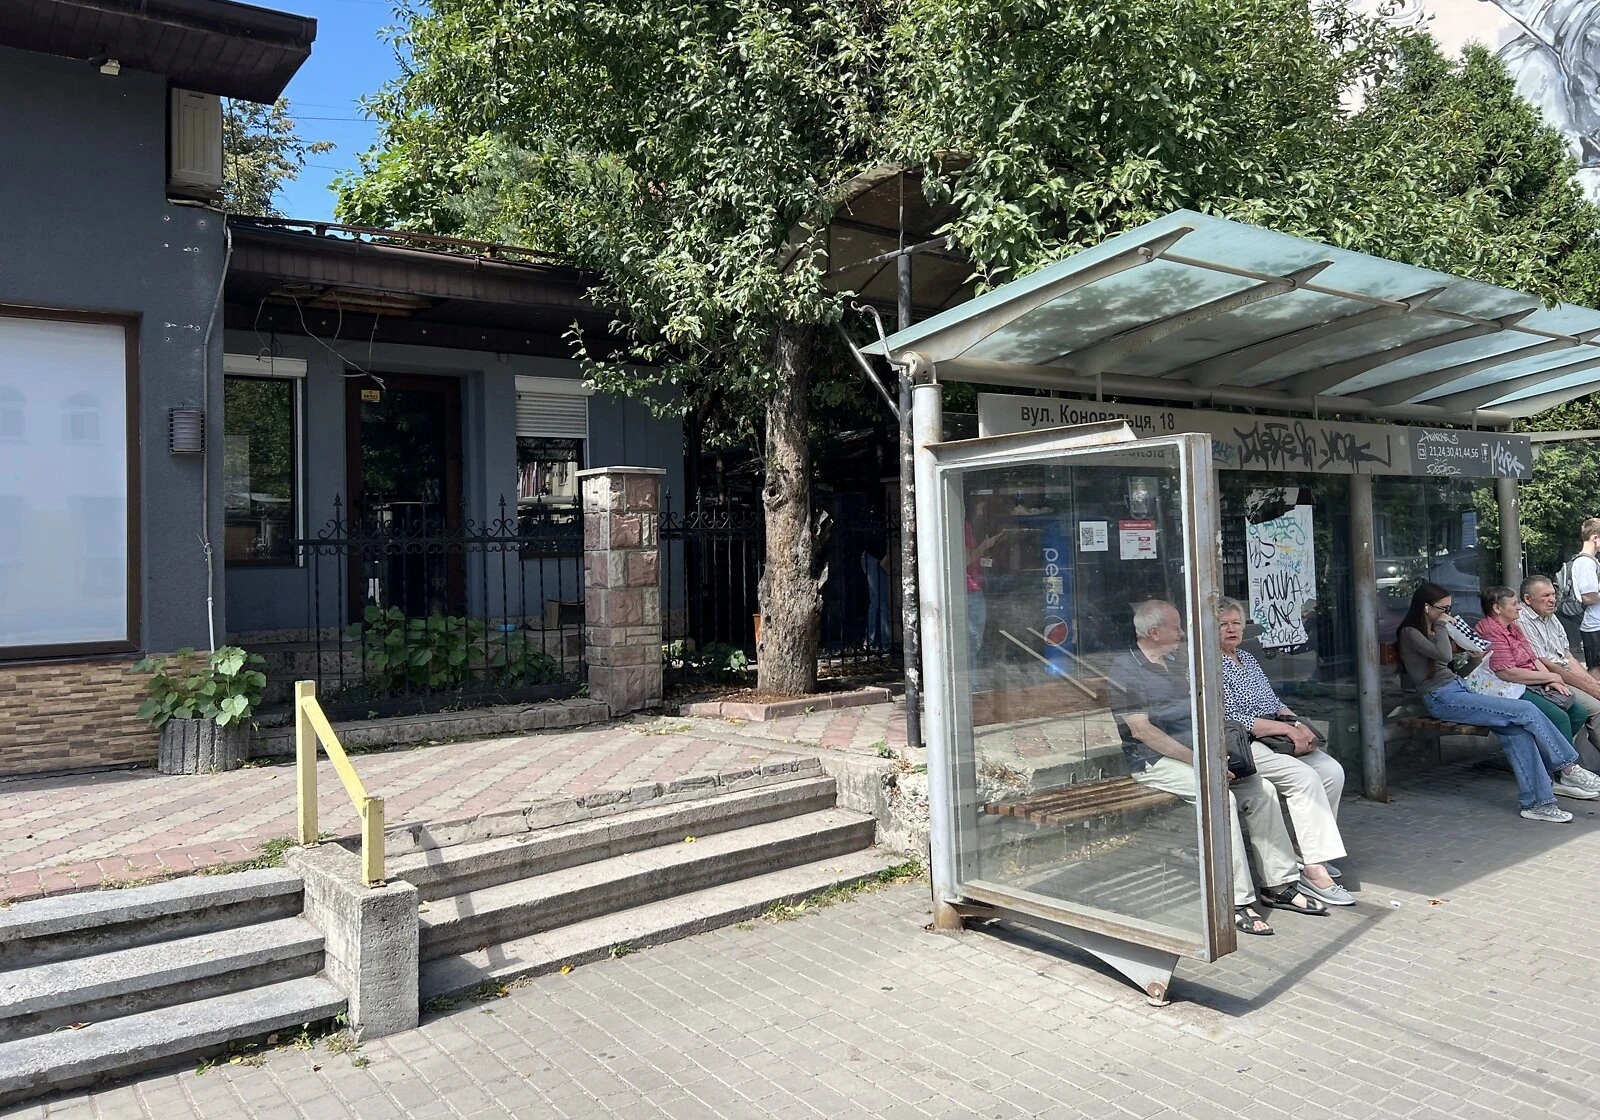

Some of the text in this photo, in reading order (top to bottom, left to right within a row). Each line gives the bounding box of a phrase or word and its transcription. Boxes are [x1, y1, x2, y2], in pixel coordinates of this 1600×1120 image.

[1021, 406, 1054, 427] вул.
[1160, 413, 1175, 430] 18
[1429, 446, 1479, 459] 21,24,30,41,44,56
[1043, 548, 1063, 610] pesi
